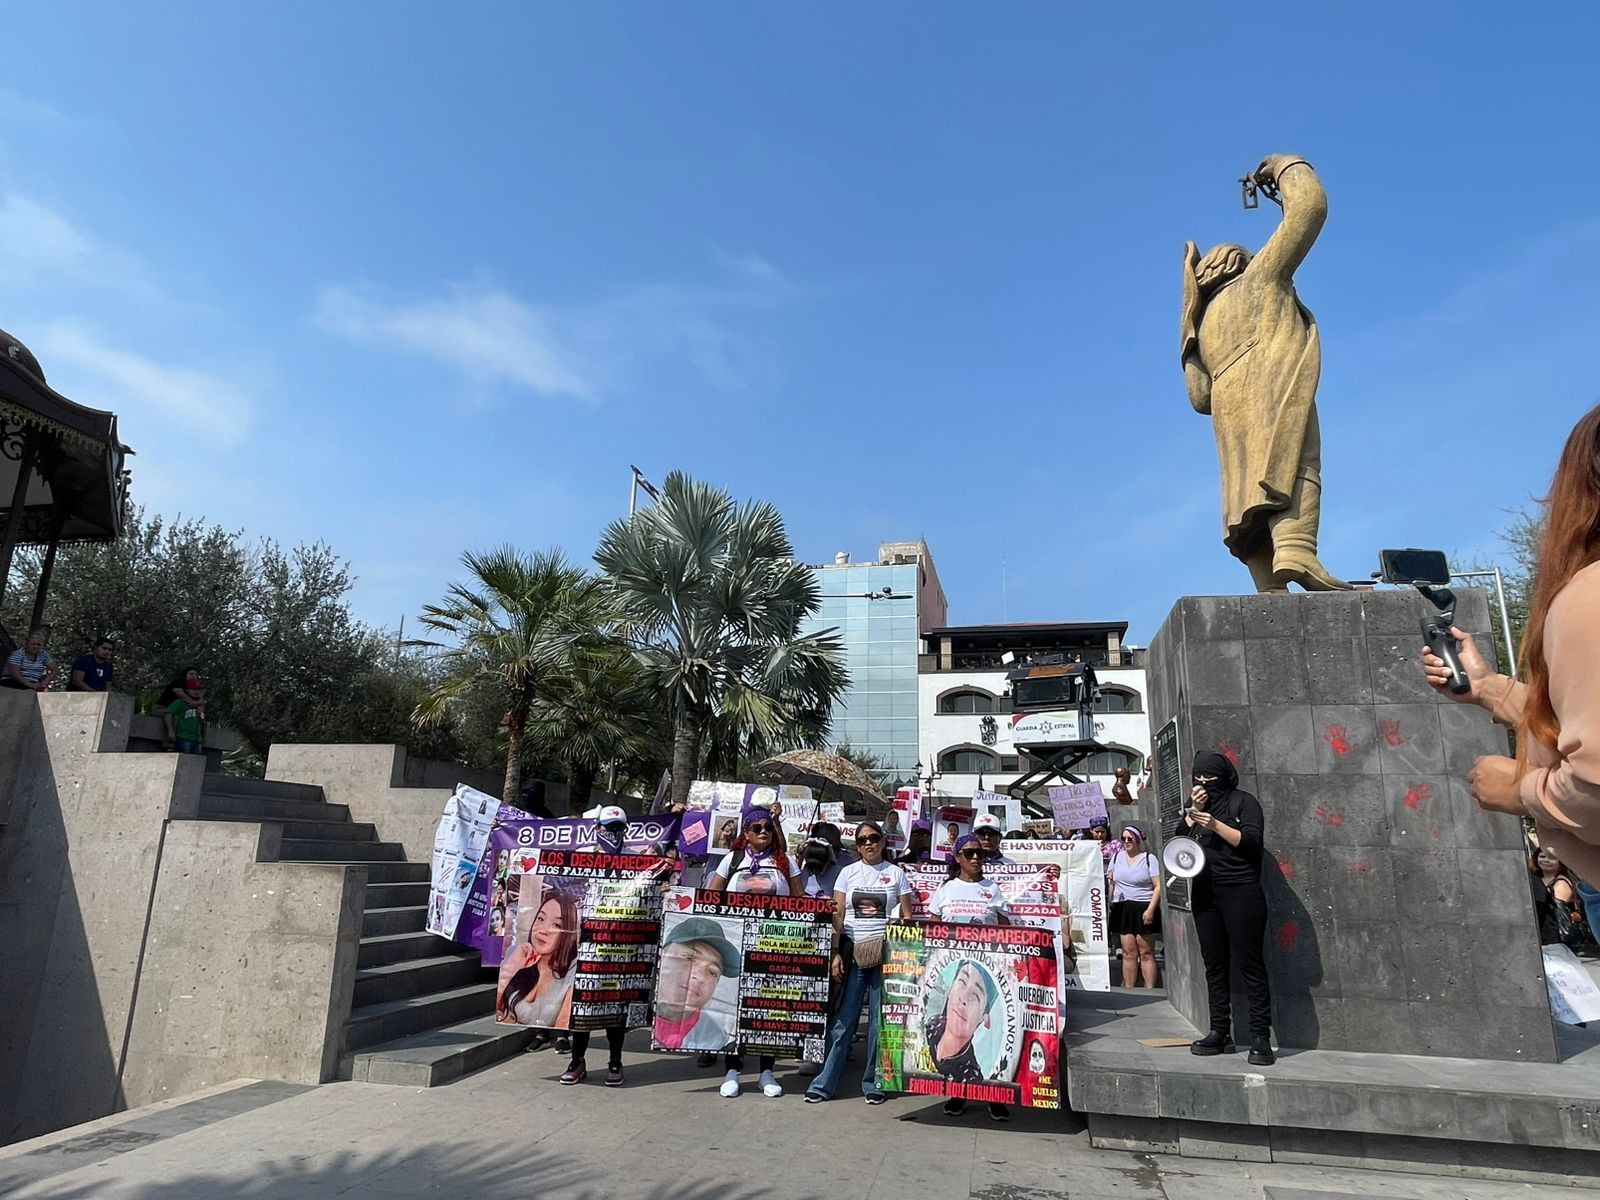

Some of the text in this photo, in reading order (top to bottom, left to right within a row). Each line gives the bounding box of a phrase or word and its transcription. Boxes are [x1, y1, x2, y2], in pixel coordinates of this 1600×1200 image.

[518, 822, 663, 845] 8 DE MRZO
[1035, 843, 1075, 851] VISTO?
[541, 852, 664, 871] LOS DESAPARECID
[538, 865, 559, 875] NOS
[562, 867, 605, 877] FALTAN
[610, 869, 618, 878] A
[696, 890, 833, 913] LOS DESAPARECIDOS
[1007, 906, 1057, 915] ALIZADA
[695, 904, 814, 921] NOS FALTAN A TODOS
[1090, 888, 1103, 941] COMPARTE
[925, 925, 949, 939] LOS
[925, 938, 1040, 956] NOS FALTAN A TODOS
[750, 953, 824, 965] GERARDO RAMON
[964, 949, 996, 971] UNIDOS
[996, 972, 1016, 1053] MEXICANOS
[1018, 986, 1054, 1006] QUEREMOS
[1022, 1013, 1055, 1031] JUSTICIA
[909, 1077, 1015, 1105] ENRIQUE RUIZ HERNANDEZ
[1032, 1087, 1058, 1097] DUELES
[1032, 1099, 1058, 1110] MEXICO
